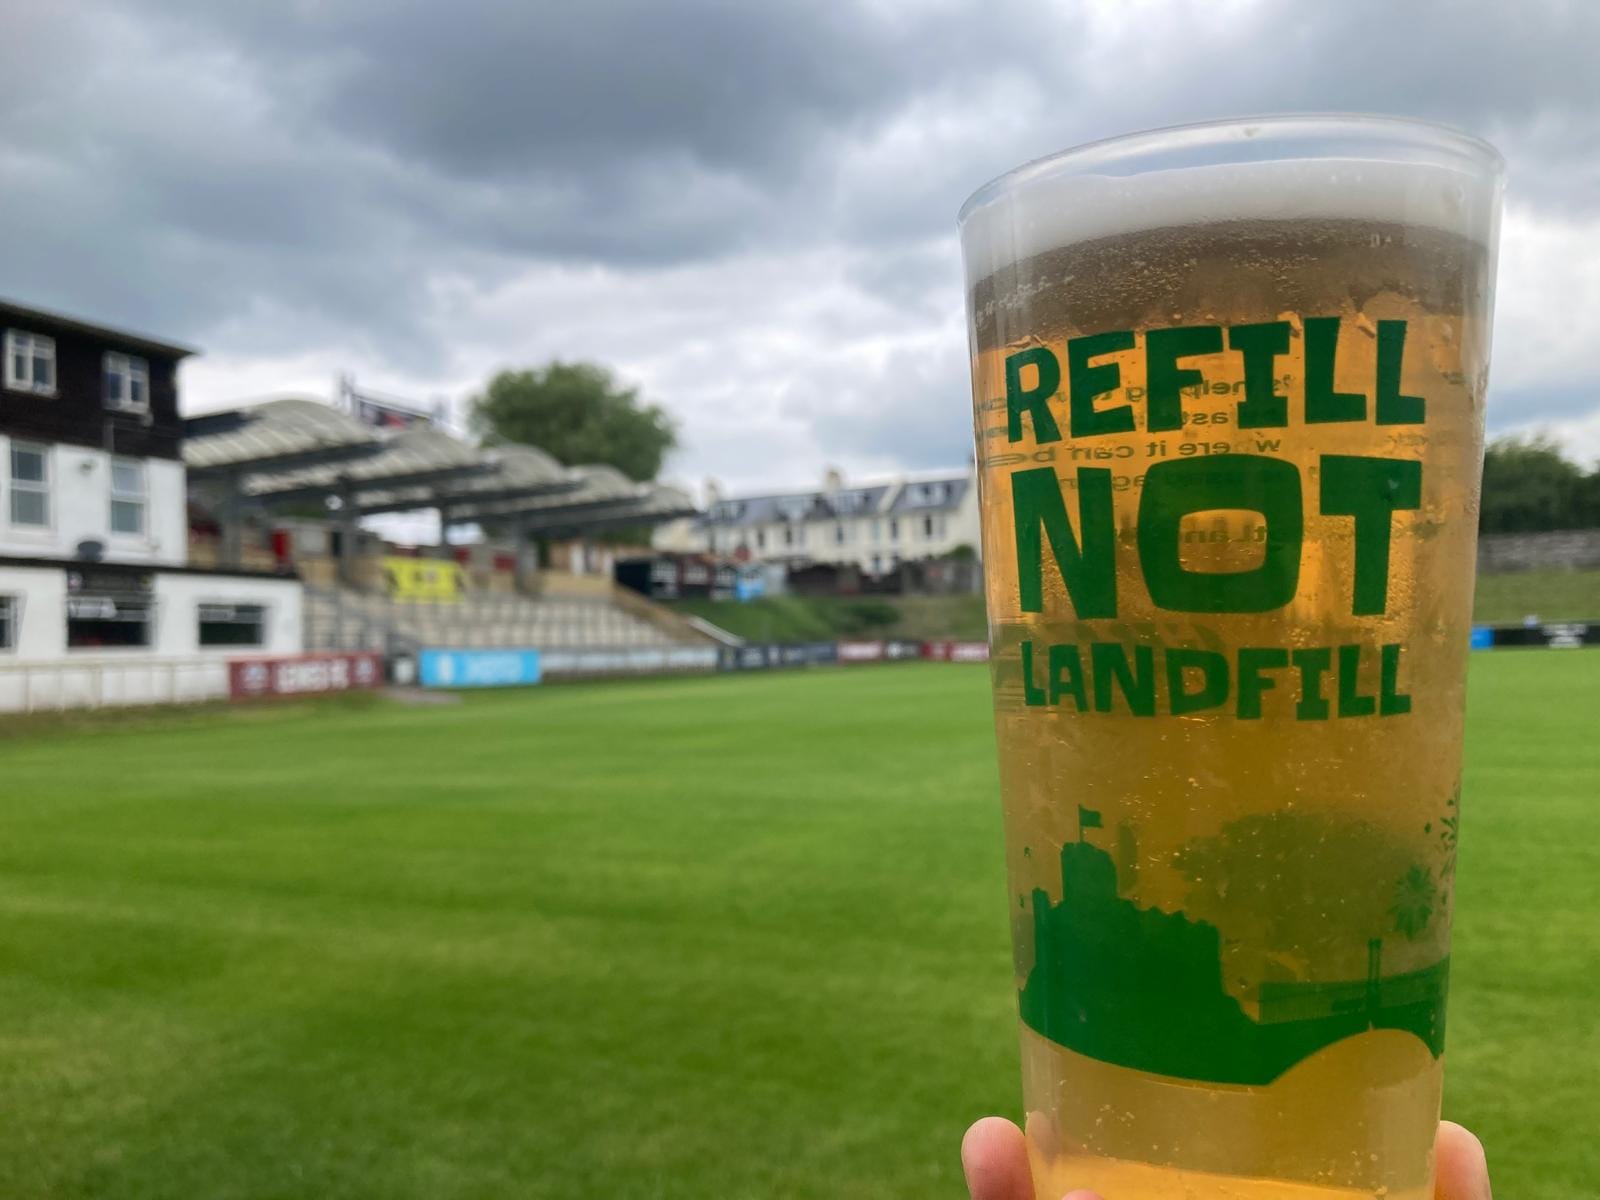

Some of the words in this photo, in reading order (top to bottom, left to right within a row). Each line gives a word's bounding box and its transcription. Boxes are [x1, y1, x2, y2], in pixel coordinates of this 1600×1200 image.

[1006, 318, 1424, 443] REFILL
[1013, 455, 1420, 618] NOT
[1022, 641, 1411, 719] LANDFILL
